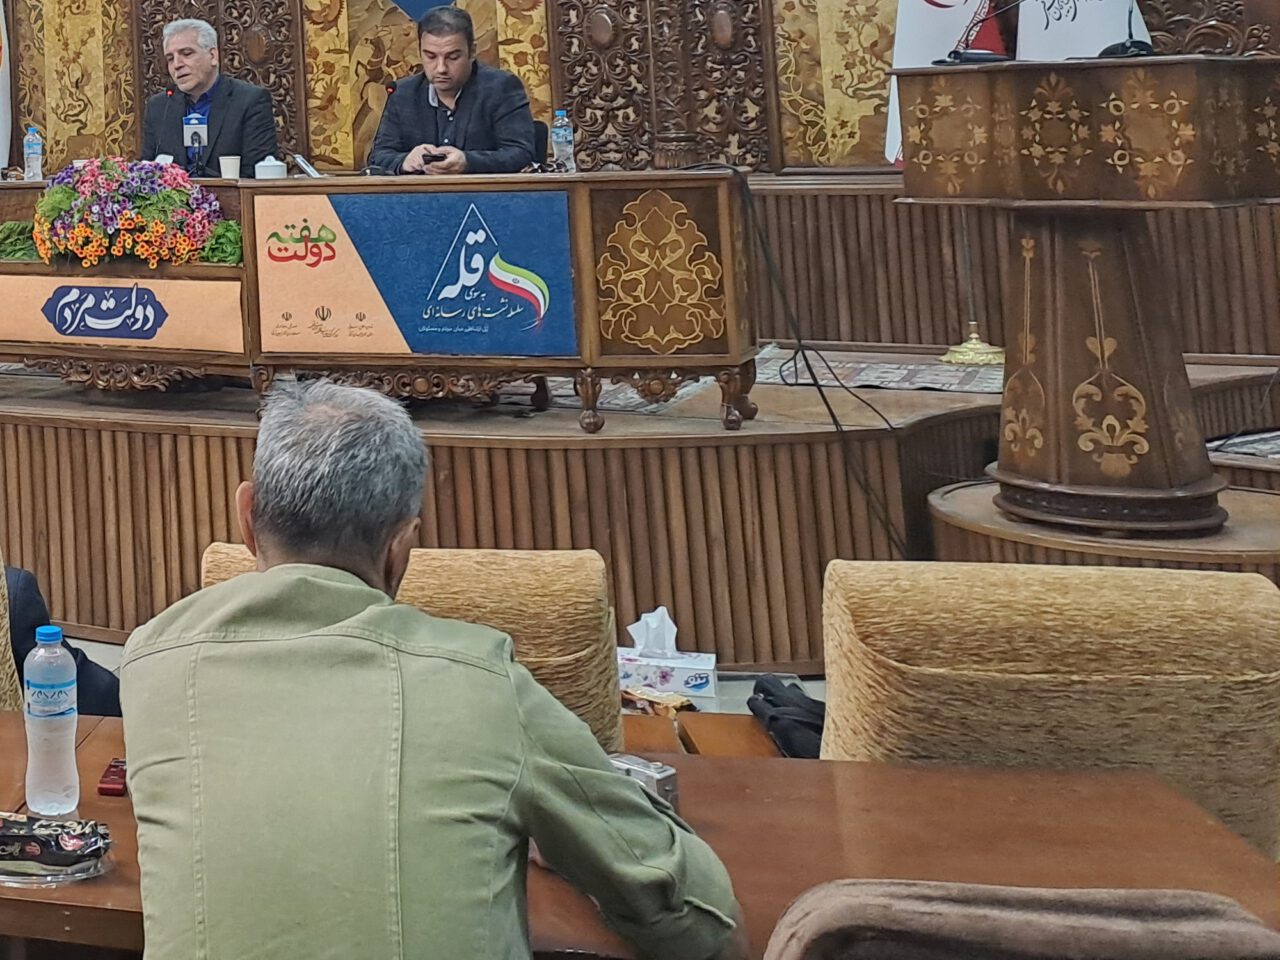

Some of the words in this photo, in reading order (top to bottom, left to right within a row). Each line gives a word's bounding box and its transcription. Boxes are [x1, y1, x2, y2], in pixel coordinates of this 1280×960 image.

[266, 218, 337, 244] هفته
[267, 235, 337, 268] دولت
[438, 228, 487, 301] قله
[464, 287, 480, 301] سوی
